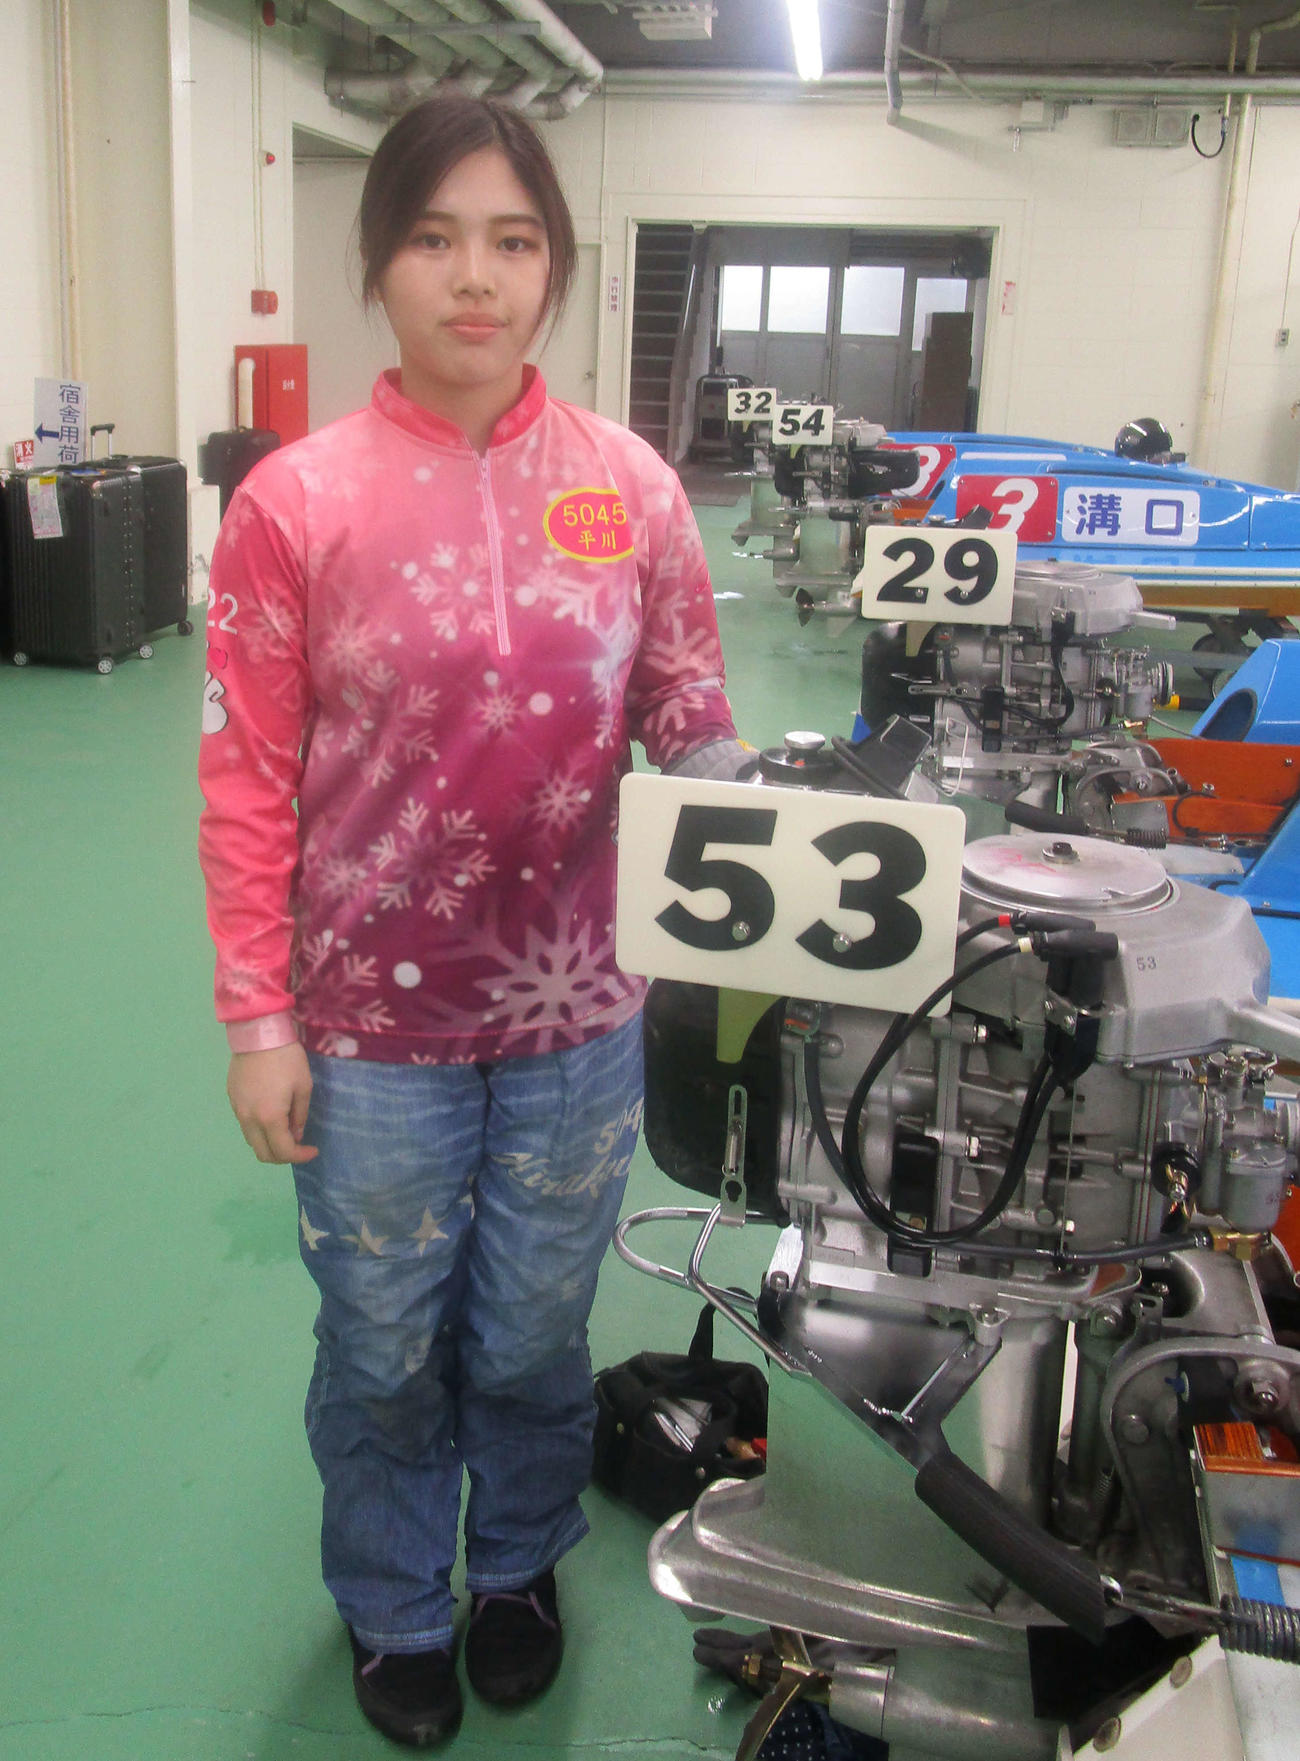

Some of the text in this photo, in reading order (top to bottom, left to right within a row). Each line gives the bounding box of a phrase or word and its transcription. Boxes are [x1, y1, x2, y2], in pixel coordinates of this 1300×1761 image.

[734, 391, 773, 414] 32
[58, 384, 81, 465] 宿舎用荷
[778, 408, 825, 437] 54
[563, 502, 627, 527] 5045
[1074, 493, 1184, 537] 溝口
[578, 529, 617, 552] 平川
[877, 537, 999, 606] 29
[654, 804, 927, 971] 53
[1136, 955, 1157, 970] 53
